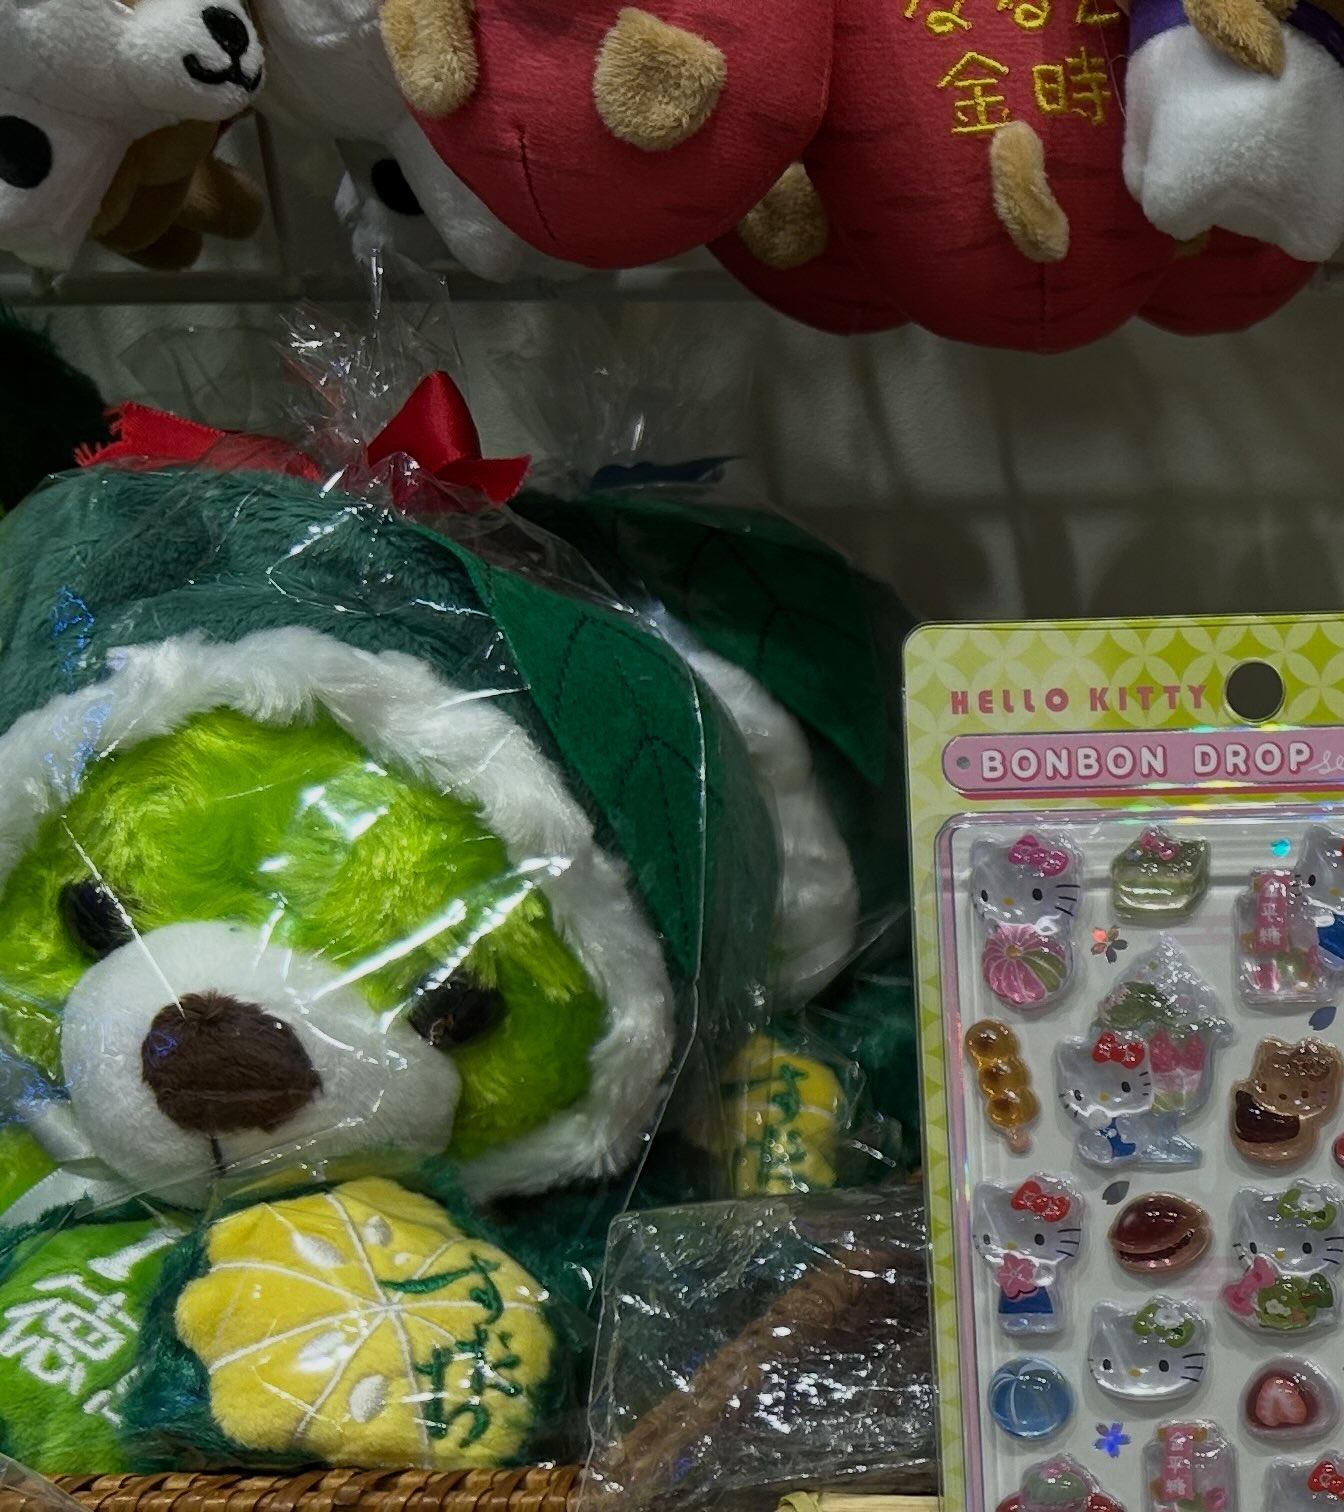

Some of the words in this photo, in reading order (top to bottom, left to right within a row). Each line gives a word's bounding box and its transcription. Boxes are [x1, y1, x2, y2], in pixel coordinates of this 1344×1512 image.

[936, 45, 1112, 135] 金時
[951, 687, 1070, 715] HELLO
[1089, 684, 1208, 712] KITTY
[979, 743, 1168, 783] BONBON
[1192, 741, 1315, 778] DROP
